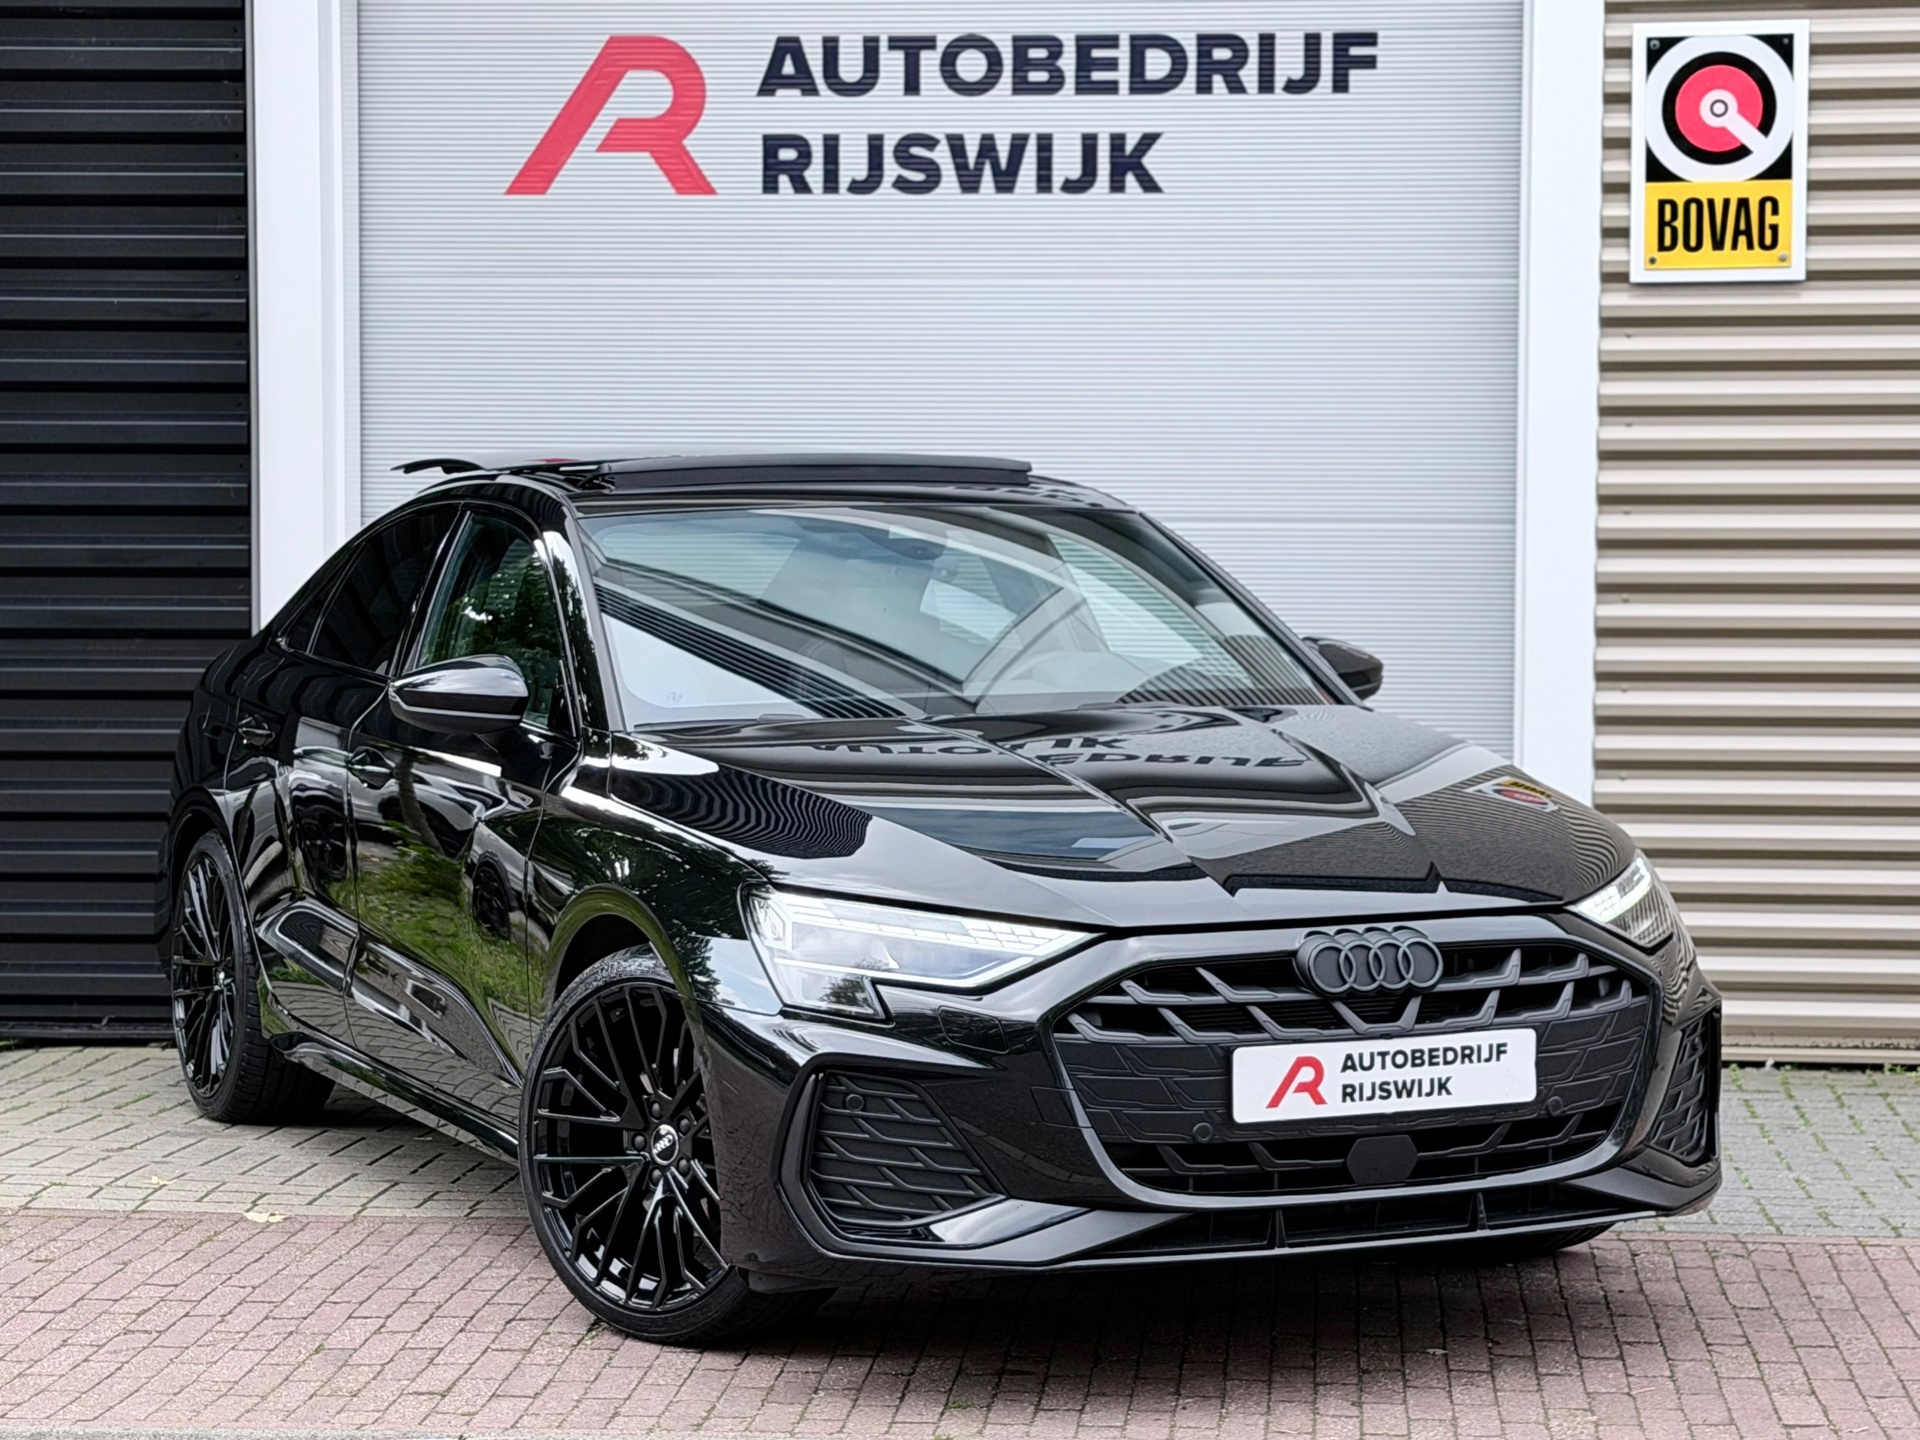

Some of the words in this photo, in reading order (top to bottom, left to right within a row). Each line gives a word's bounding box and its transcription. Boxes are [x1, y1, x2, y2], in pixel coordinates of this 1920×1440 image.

[757, 32, 1378, 96] AUTOBEDRIJF
[763, 133, 1162, 194] RIJSWIJK
[1657, 196, 1779, 253] BOVAG
[1340, 1042, 1508, 1073] AUTOBEDRIJF
[1341, 1076, 1453, 1103] RIJSWIJK
